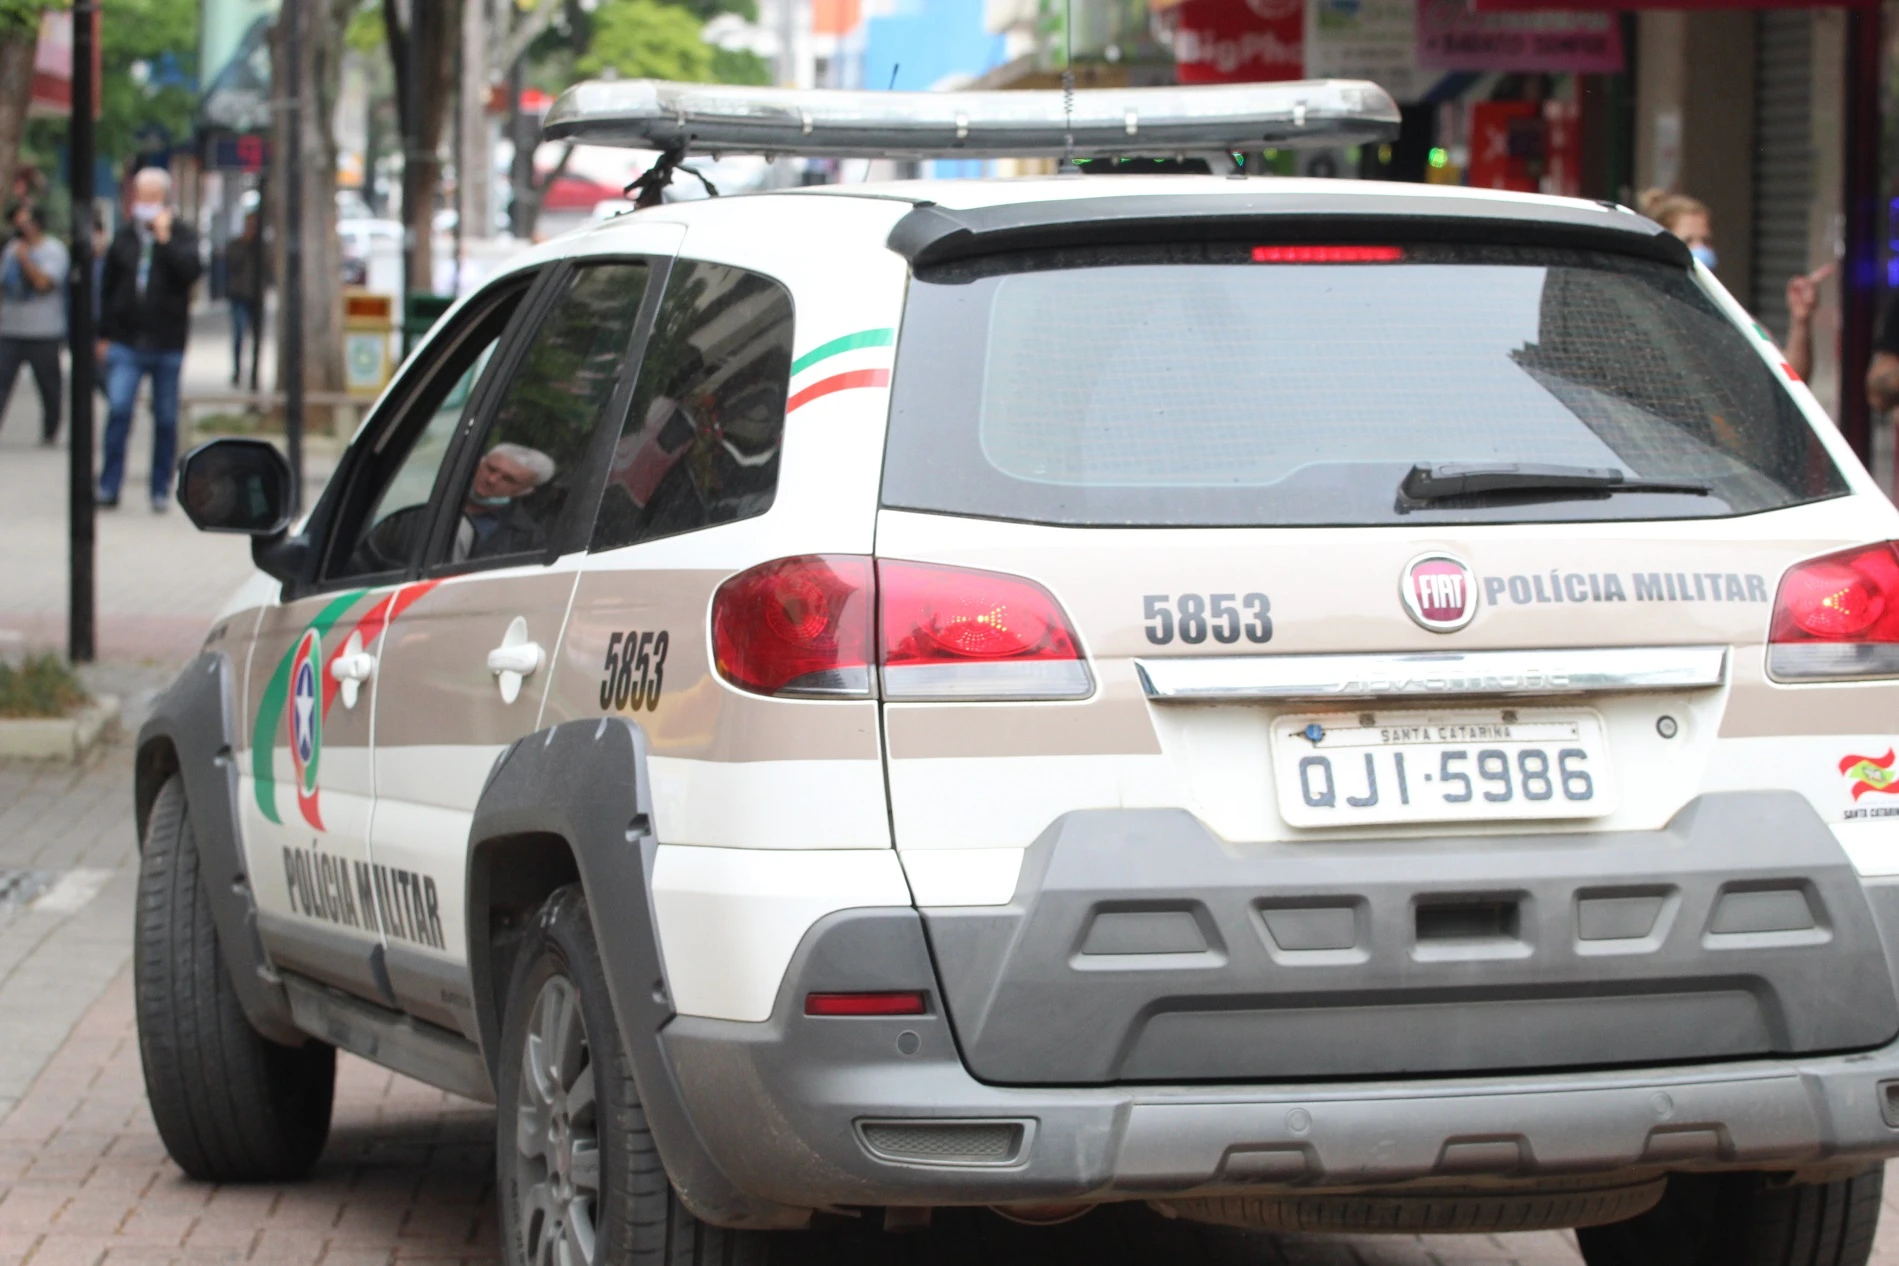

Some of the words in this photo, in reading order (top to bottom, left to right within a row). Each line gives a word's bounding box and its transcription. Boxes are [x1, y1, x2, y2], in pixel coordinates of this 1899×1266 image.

[1418, 573, 1465, 610] FIAT
[1483, 569, 1627, 606] POLÍCIA
[1631, 572, 1769, 603] MILITAR
[1142, 592, 1274, 646] 5853
[600, 630, 670, 712] 5853
[1381, 728, 1431, 743] SANTA
[1438, 726, 1512, 741] CATARINA
[282, 838, 360, 929] POLÍCIA
[354, 861, 447, 951] MILITAR
